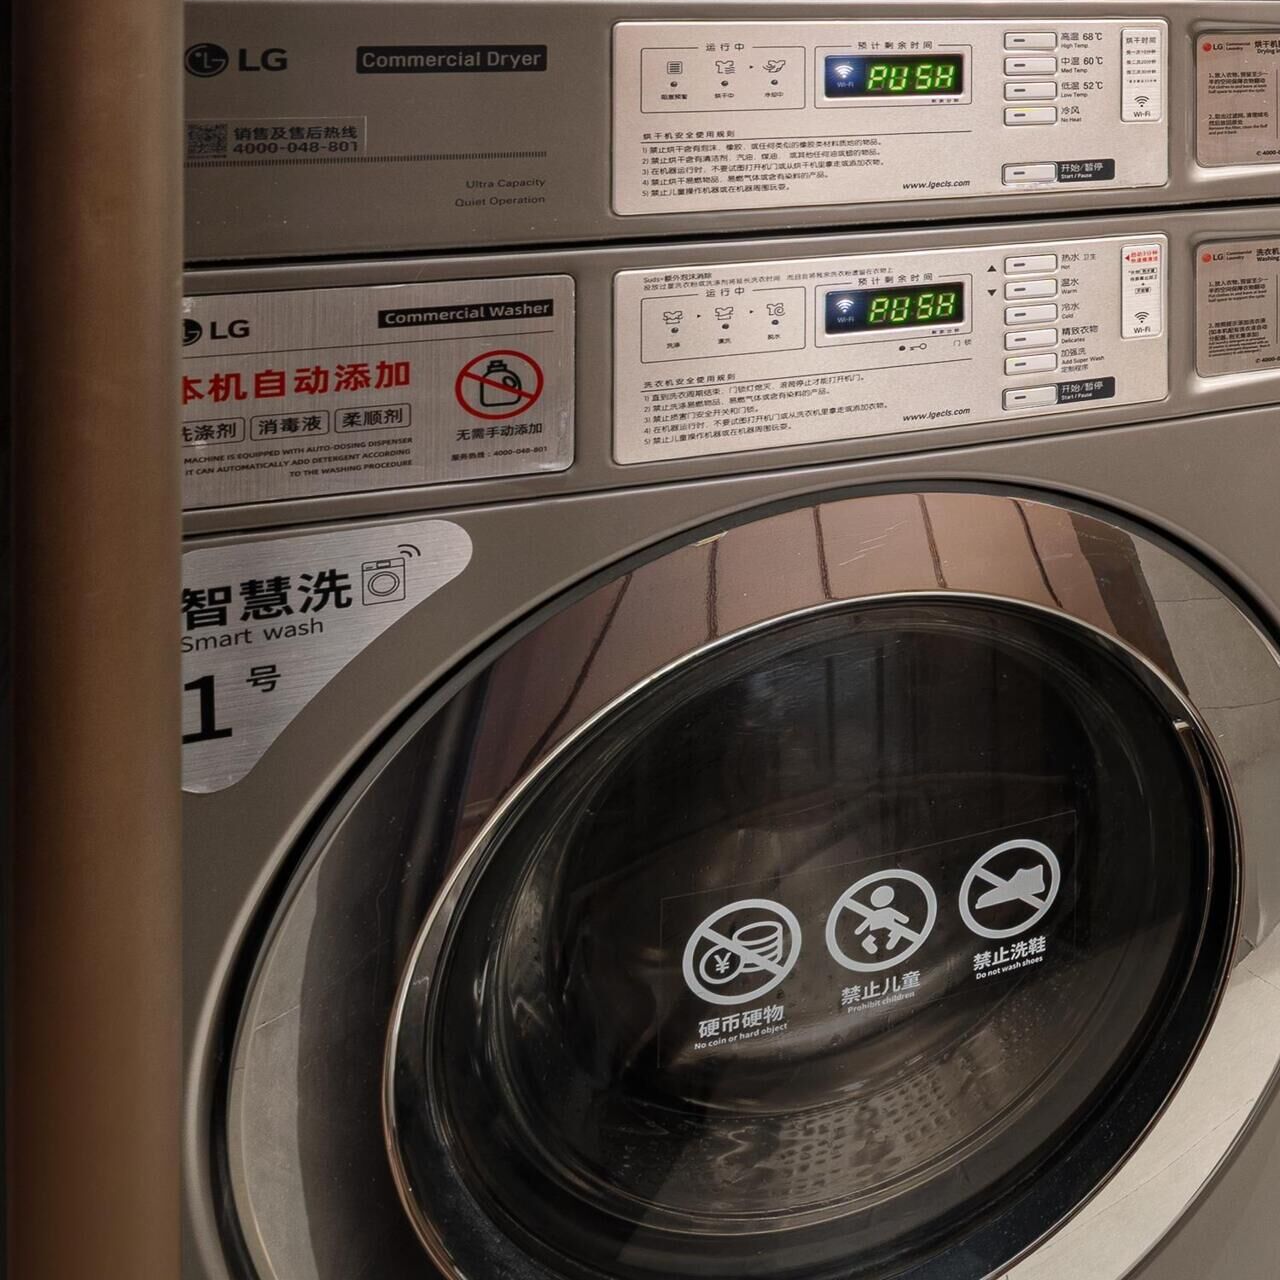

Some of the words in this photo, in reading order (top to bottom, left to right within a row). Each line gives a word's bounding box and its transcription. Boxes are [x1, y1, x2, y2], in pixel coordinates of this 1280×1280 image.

[238, 48, 287, 72] LG
[362, 51, 481, 68] Commercial
[487, 52, 542, 67] Dryer
[866, 64, 955, 91] PUSH
[234, 125, 357, 140] 销售及售后热线
[233, 141, 359, 154] 4000-048-801
[466, 179, 494, 189] Ultra
[497, 178, 546, 190] Capacity
[455, 197, 486, 207] Quiet
[489, 195, 546, 207] Operation
[210, 320, 250, 339] LG
[385, 306, 484, 324] Commercial
[488, 302, 549, 317] Washer
[869, 292, 955, 322] PUSH
[258, 415, 322, 435] 消毒液
[342, 410, 403, 428] 柔顺剂
[456, 423, 543, 441] 无需手动添加
[182, 569, 353, 631] 智慧洗
[182, 630, 252, 652] Smart
[264, 618, 324, 640] wash
[182, 675, 232, 745] 1
[246, 664, 281, 692] 号
[973, 935, 1047, 971] 禁止洗鞋
[976, 971, 986, 980] Do
[987, 968, 1000, 976] not
[1001, 963, 1021, 974] wash
[1022, 955, 1043, 968] shoes
[841, 970, 921, 1006] 禁止儿童
[847, 998, 880, 1014] Prohibit
[882, 990, 915, 1006] children
[698, 1004, 784, 1038] 硬币硬物
[694, 1041, 706, 1050] No
[708, 1037, 726, 1047] coin
[728, 1035, 737, 1043] or
[739, 1029, 759, 1040] hard
[761, 1023, 788, 1038] object
